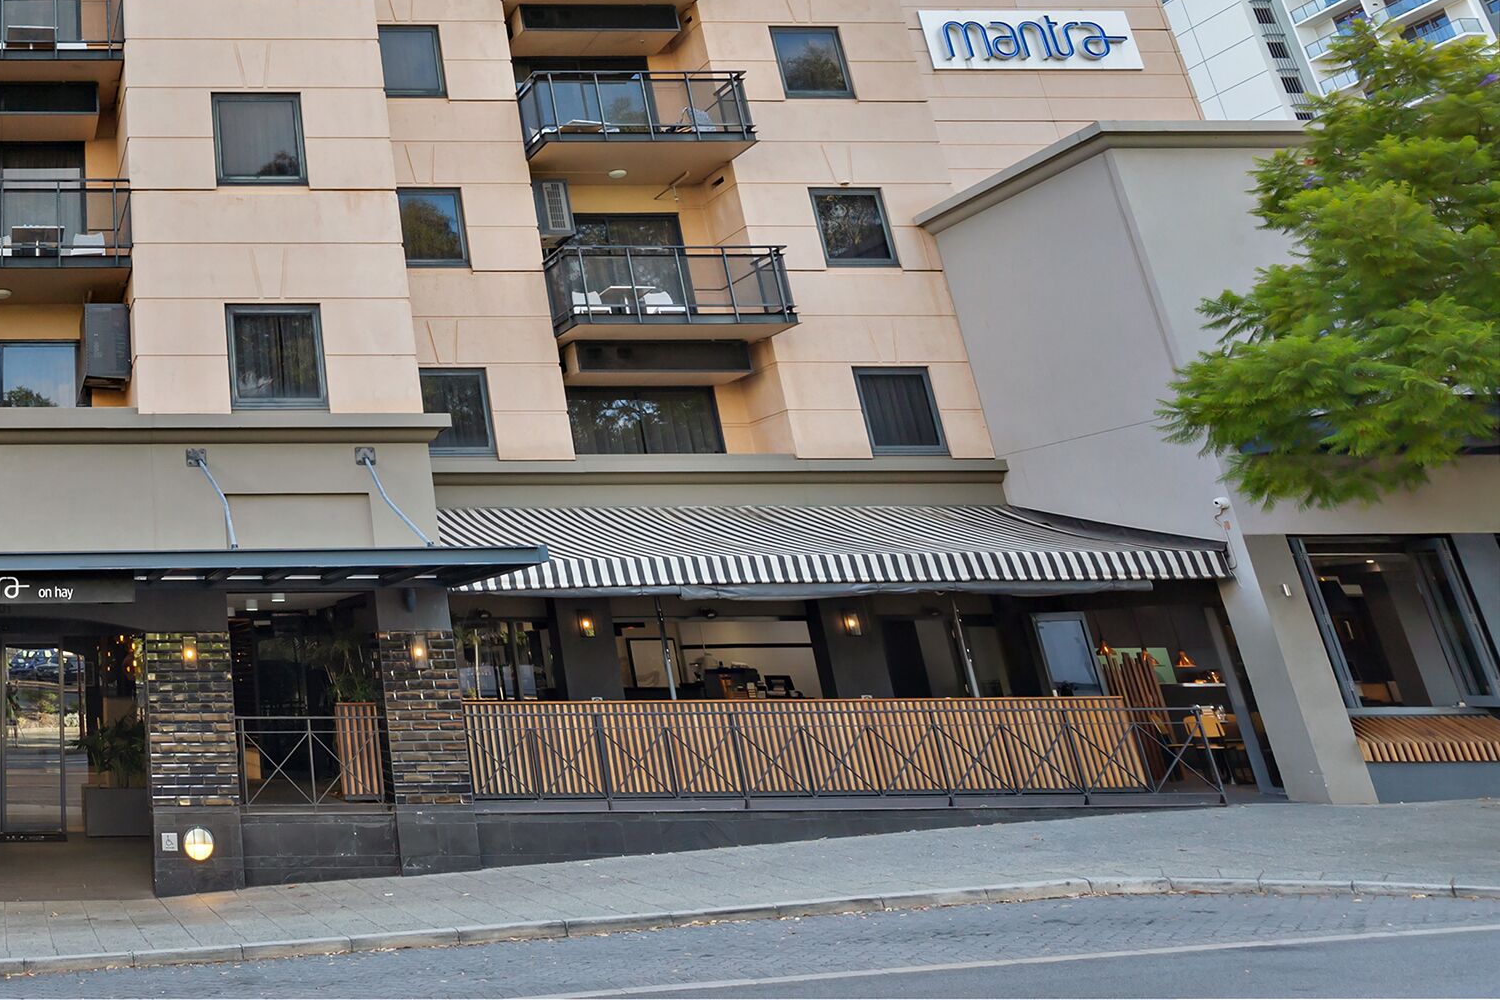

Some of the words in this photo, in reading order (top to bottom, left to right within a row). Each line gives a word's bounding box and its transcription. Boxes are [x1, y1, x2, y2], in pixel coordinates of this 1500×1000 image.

[940, 15, 1128, 60] mantra
[38, 588, 52, 598] on
[55, 586, 73, 600] hay
